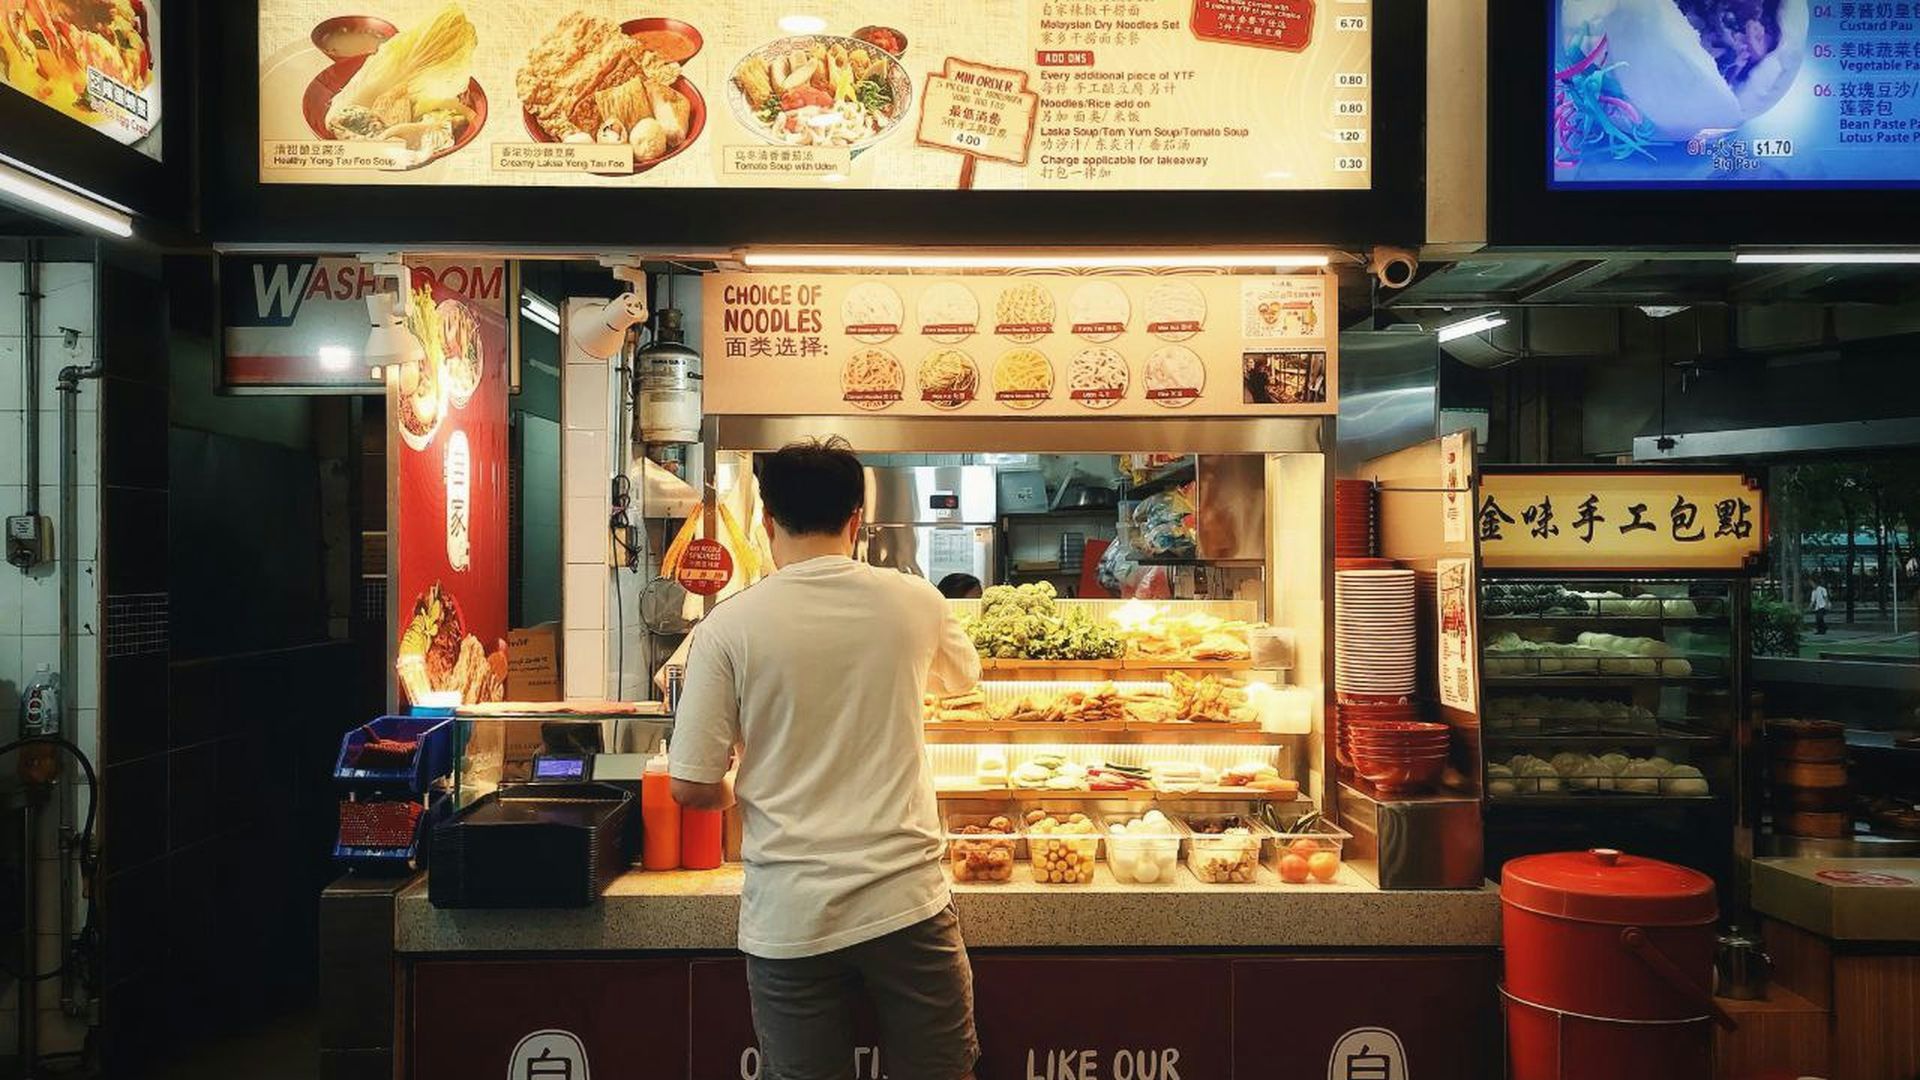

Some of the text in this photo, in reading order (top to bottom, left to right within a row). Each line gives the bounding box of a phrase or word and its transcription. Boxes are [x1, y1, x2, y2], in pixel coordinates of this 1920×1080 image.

[1041, 20, 1180, 31] Malaysian Dry Noodles Set
[1340, 19, 1362, 29] 6.70
[1840, 20, 1913, 31] Custard Pau
[1813, 44, 1836, 58] 05.
[1045, 53, 1087, 64] ADD ONS
[1840, 59, 1903, 73] Vegetable
[1041, 71, 1195, 83] Every additional piece of YTF
[1340, 75, 1361, 85] 0.80
[976, 76, 1014, 93] ORDER
[1813, 84, 1836, 98] 06.
[1114, 99, 1135, 109] add
[1137, 100, 1151, 109] on
[1340, 103, 1361, 113] 0.80
[1840, 99, 1894, 116] 莲蓉包
[1840, 119, 1870, 130] Bean
[1873, 119, 1907, 130] Paste
[1129, 127, 1151, 137] Yum
[1223, 127, 1249, 138] Soup
[1340, 131, 1358, 141] 1.20
[1840, 132, 1874, 143] Lotus
[1877, 132, 1910, 143] Paste
[1757, 140, 1792, 156] $1.70
[274, 156, 398, 168] Healthy Yong Tau Foo Soup
[500, 159, 535, 169] Creamy
[565, 159, 588, 170] Yong
[590, 160, 606, 168] Tau
[608, 160, 625, 168] Foo
[1041, 156, 1209, 167] Charge applicable for takeaway
[1340, 159, 1361, 169] 0.30
[1713, 157, 1760, 170] Big Pau
[735, 162, 838, 173] Tomato Soup with Udon
[724, 285, 822, 306] CHOICE OF
[724, 308, 823, 334] NOODLES
[725, 336, 834, 358] 面类选择:
[1479, 493, 1754, 544] 金味手工包點
[1026, 1048, 1181, 1080] LIKE OUR
